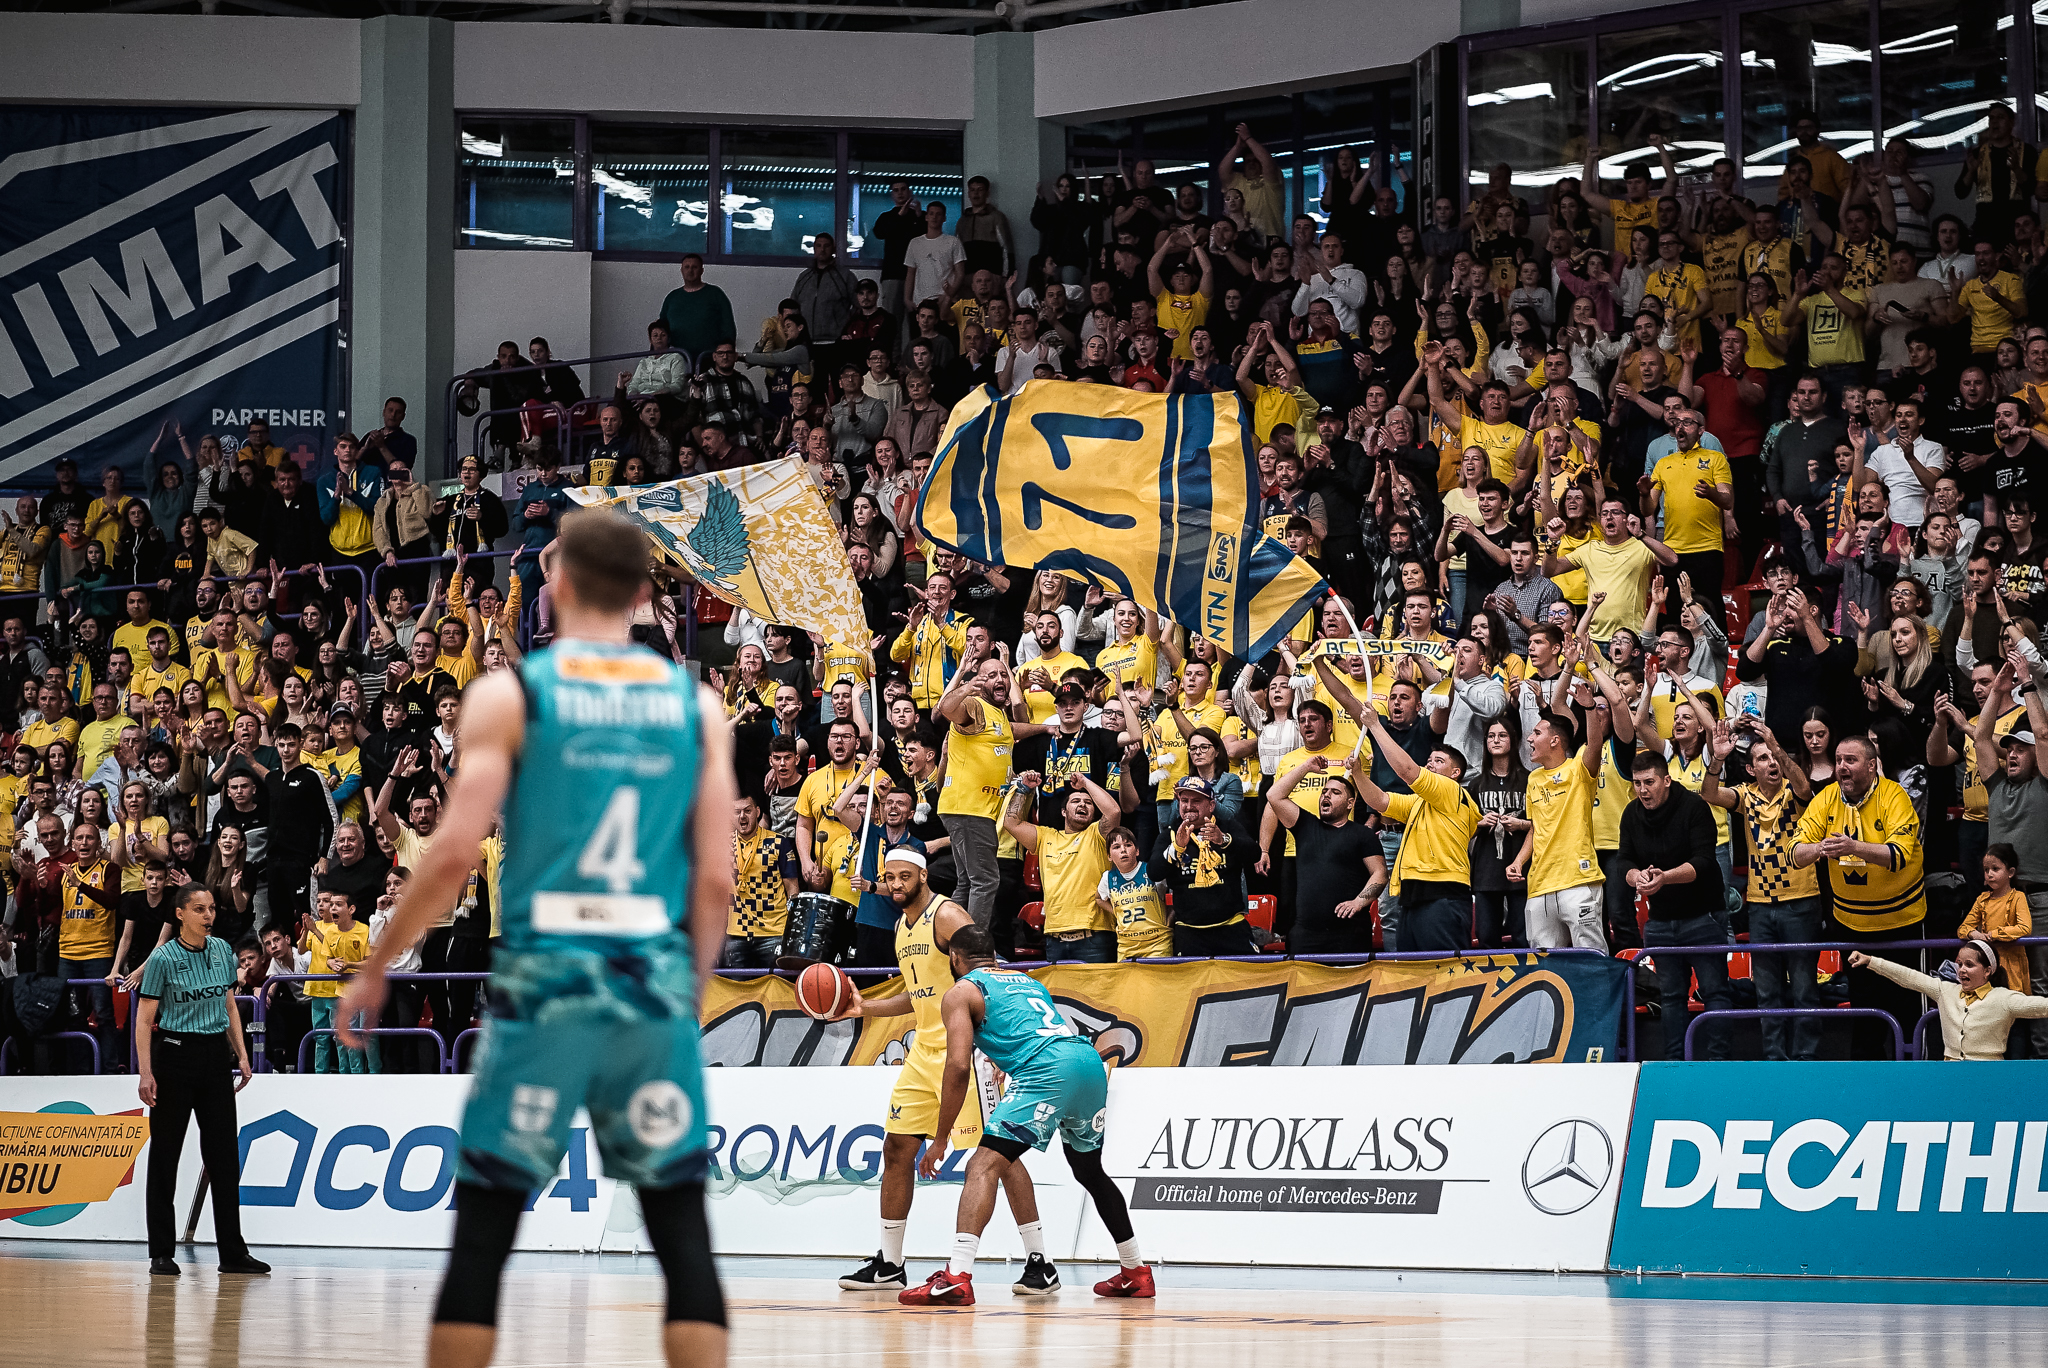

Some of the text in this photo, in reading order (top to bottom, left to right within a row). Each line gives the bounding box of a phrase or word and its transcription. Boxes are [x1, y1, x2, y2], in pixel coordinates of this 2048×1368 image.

[1500, 268, 1508, 280] 6
[212, 409, 327, 427] PARTENER
[597, 470, 604, 482] 0
[1273, 516, 1286, 525] CSU
[1207, 536, 1230, 643] NTN SNR
[187, 625, 198, 639] 28
[1326, 641, 1348, 655] BC
[1401, 641, 1446, 661] SIBIU
[829, 657, 843, 668] CSU
[1479, 790, 1527, 810] NIRVANA
[577, 784, 648, 893] 4
[75, 889, 84, 906] 6
[1120, 897, 1134, 906] CSU
[1136, 895, 1155, 904] SIBIU
[76, 908, 96, 920] FANS
[1122, 907, 1147, 925] 22
[911, 962, 918, 985] 1
[46, 1123, 124, 1141] COFINANȚATĂ
[126, 1126, 143, 1140] DE
[49, 1144, 133, 1159] MUNICIPIULUI
[1139, 1117, 1453, 1172] AUTOKLASS
[1154, 1183, 1417, 1206] Official home of Mercedes-Benz
